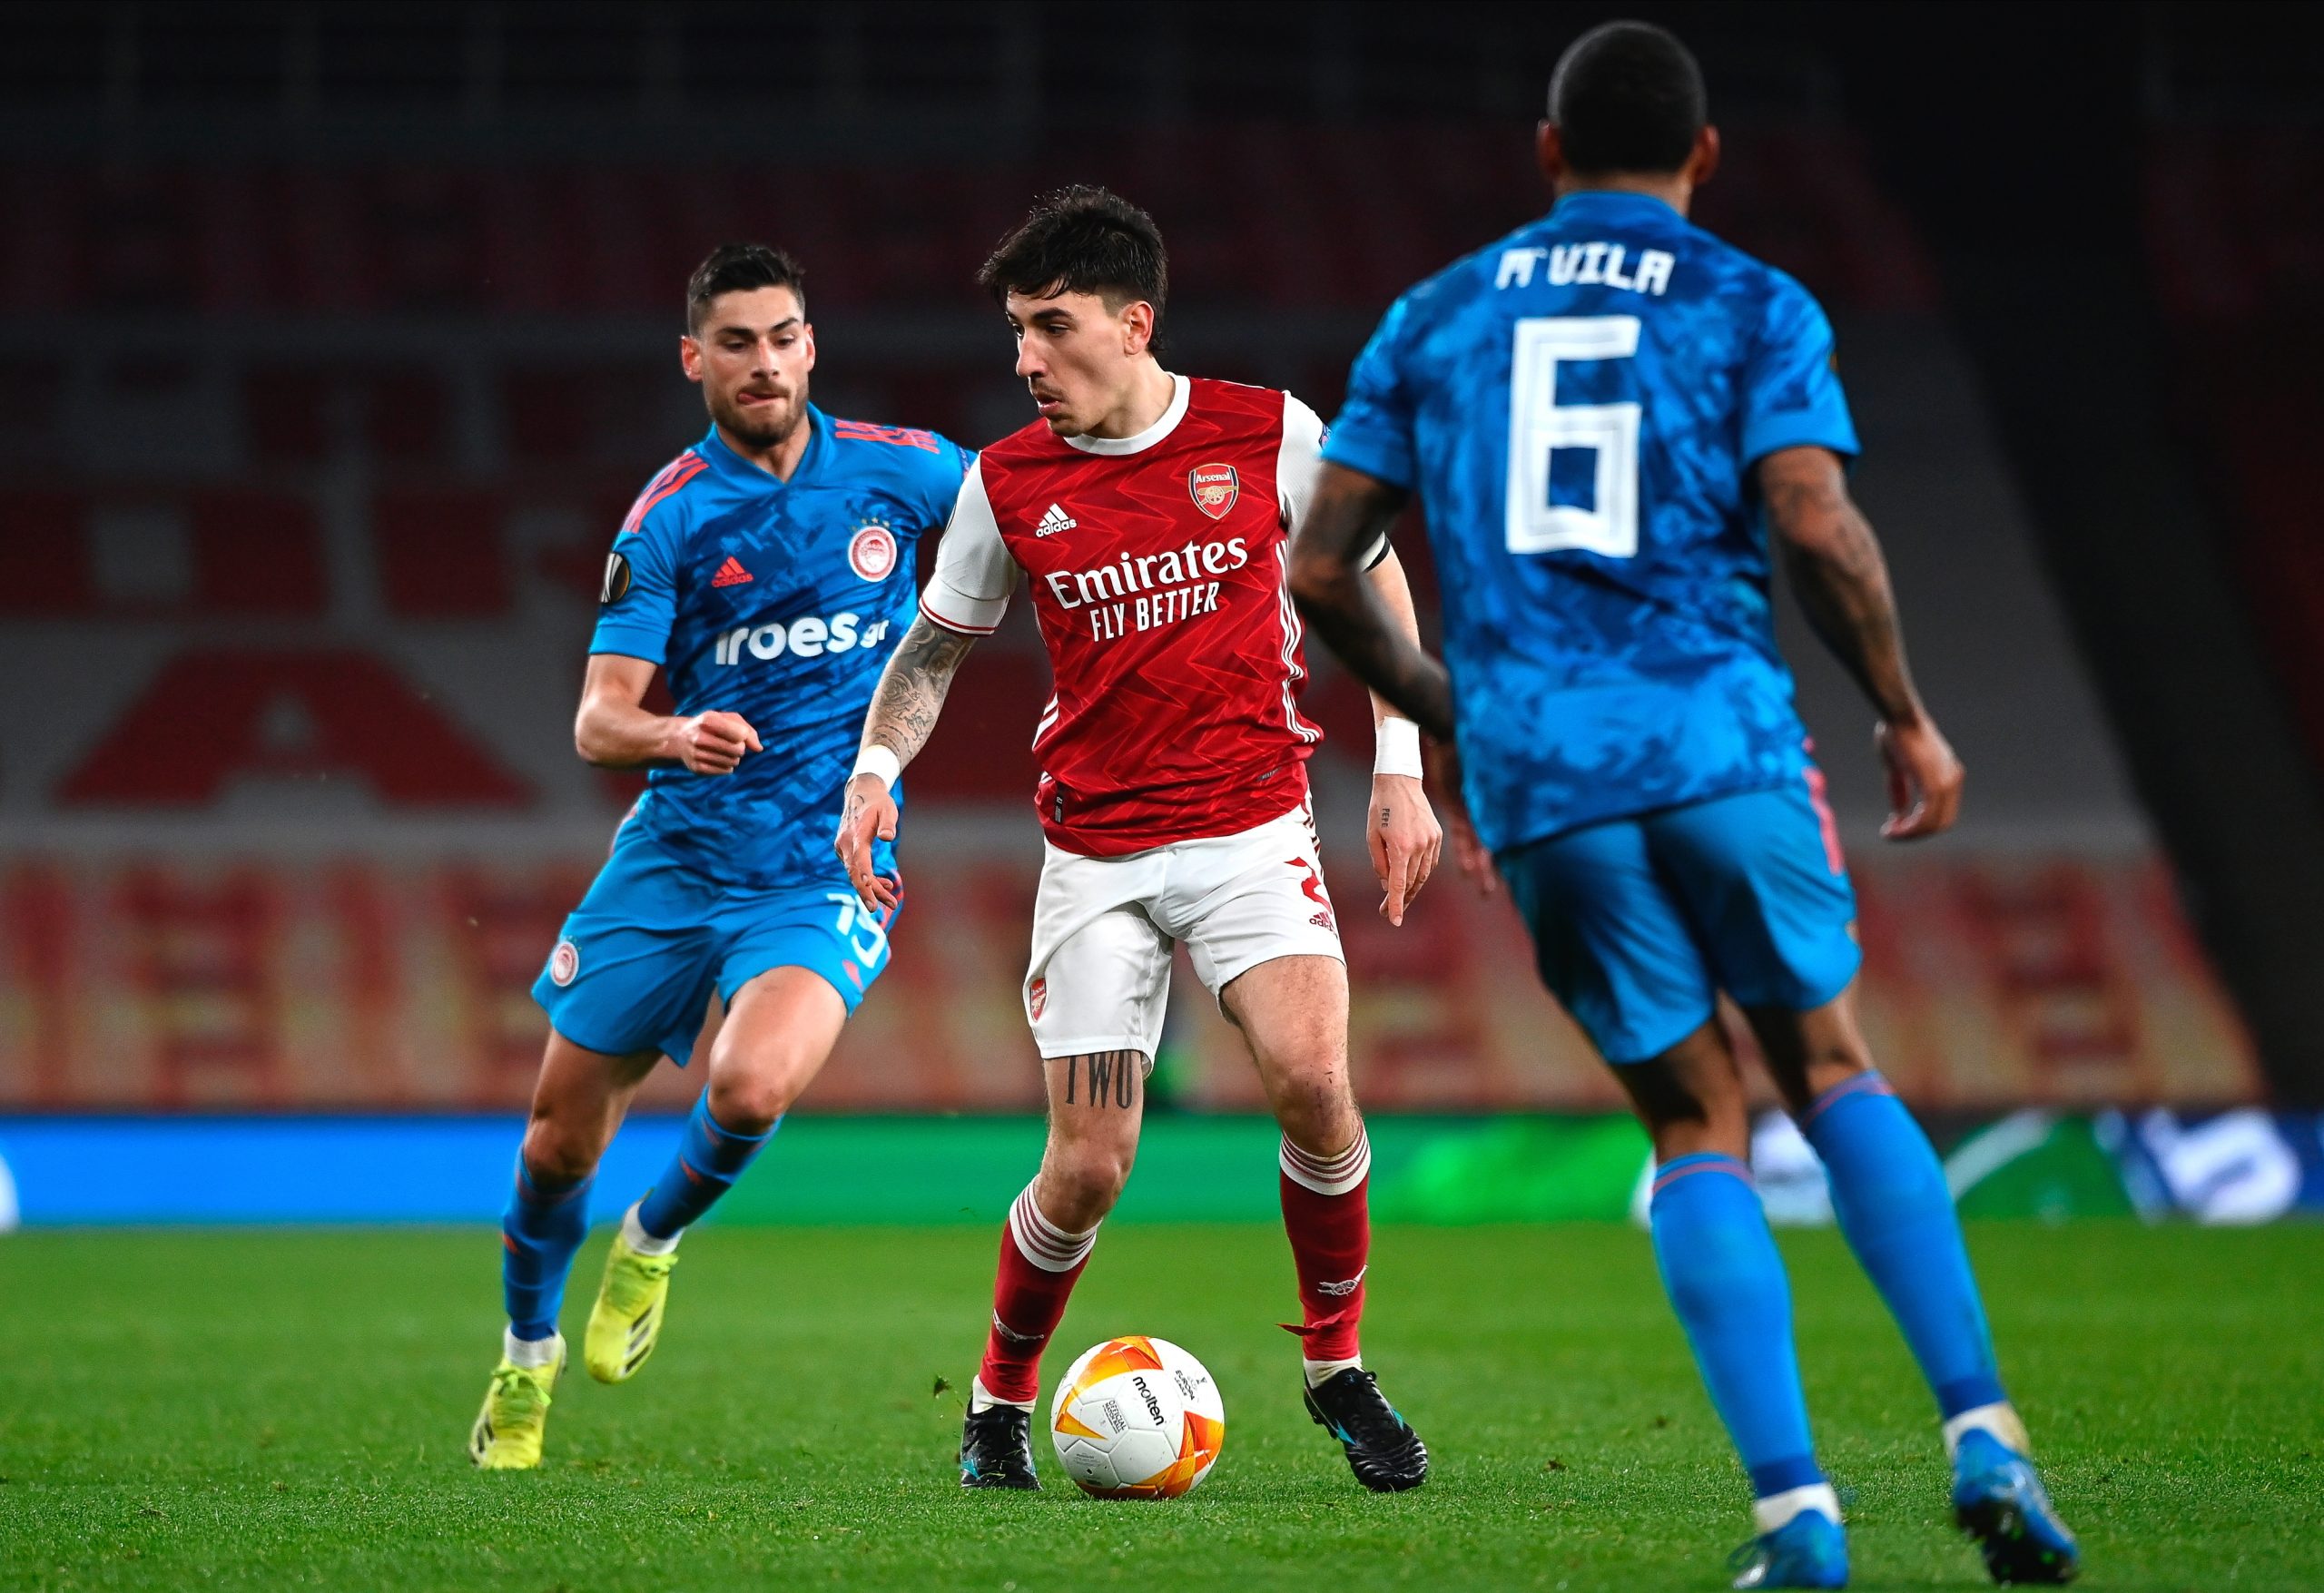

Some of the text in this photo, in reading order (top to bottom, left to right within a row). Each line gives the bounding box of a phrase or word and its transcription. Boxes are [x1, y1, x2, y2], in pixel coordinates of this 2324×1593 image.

[1505, 315, 1641, 558] 6
[1196, 471, 1231, 483] Arsenal
[1036, 517, 1078, 538] adidas
[1045, 537, 1248, 610] Emirates
[1089, 582, 1220, 643] FLY BETTER
[1381, 808, 1391, 828] PEPE
[1108, 1400, 1128, 1431] OFFICIAL
[1132, 1376, 1165, 1426] molten
